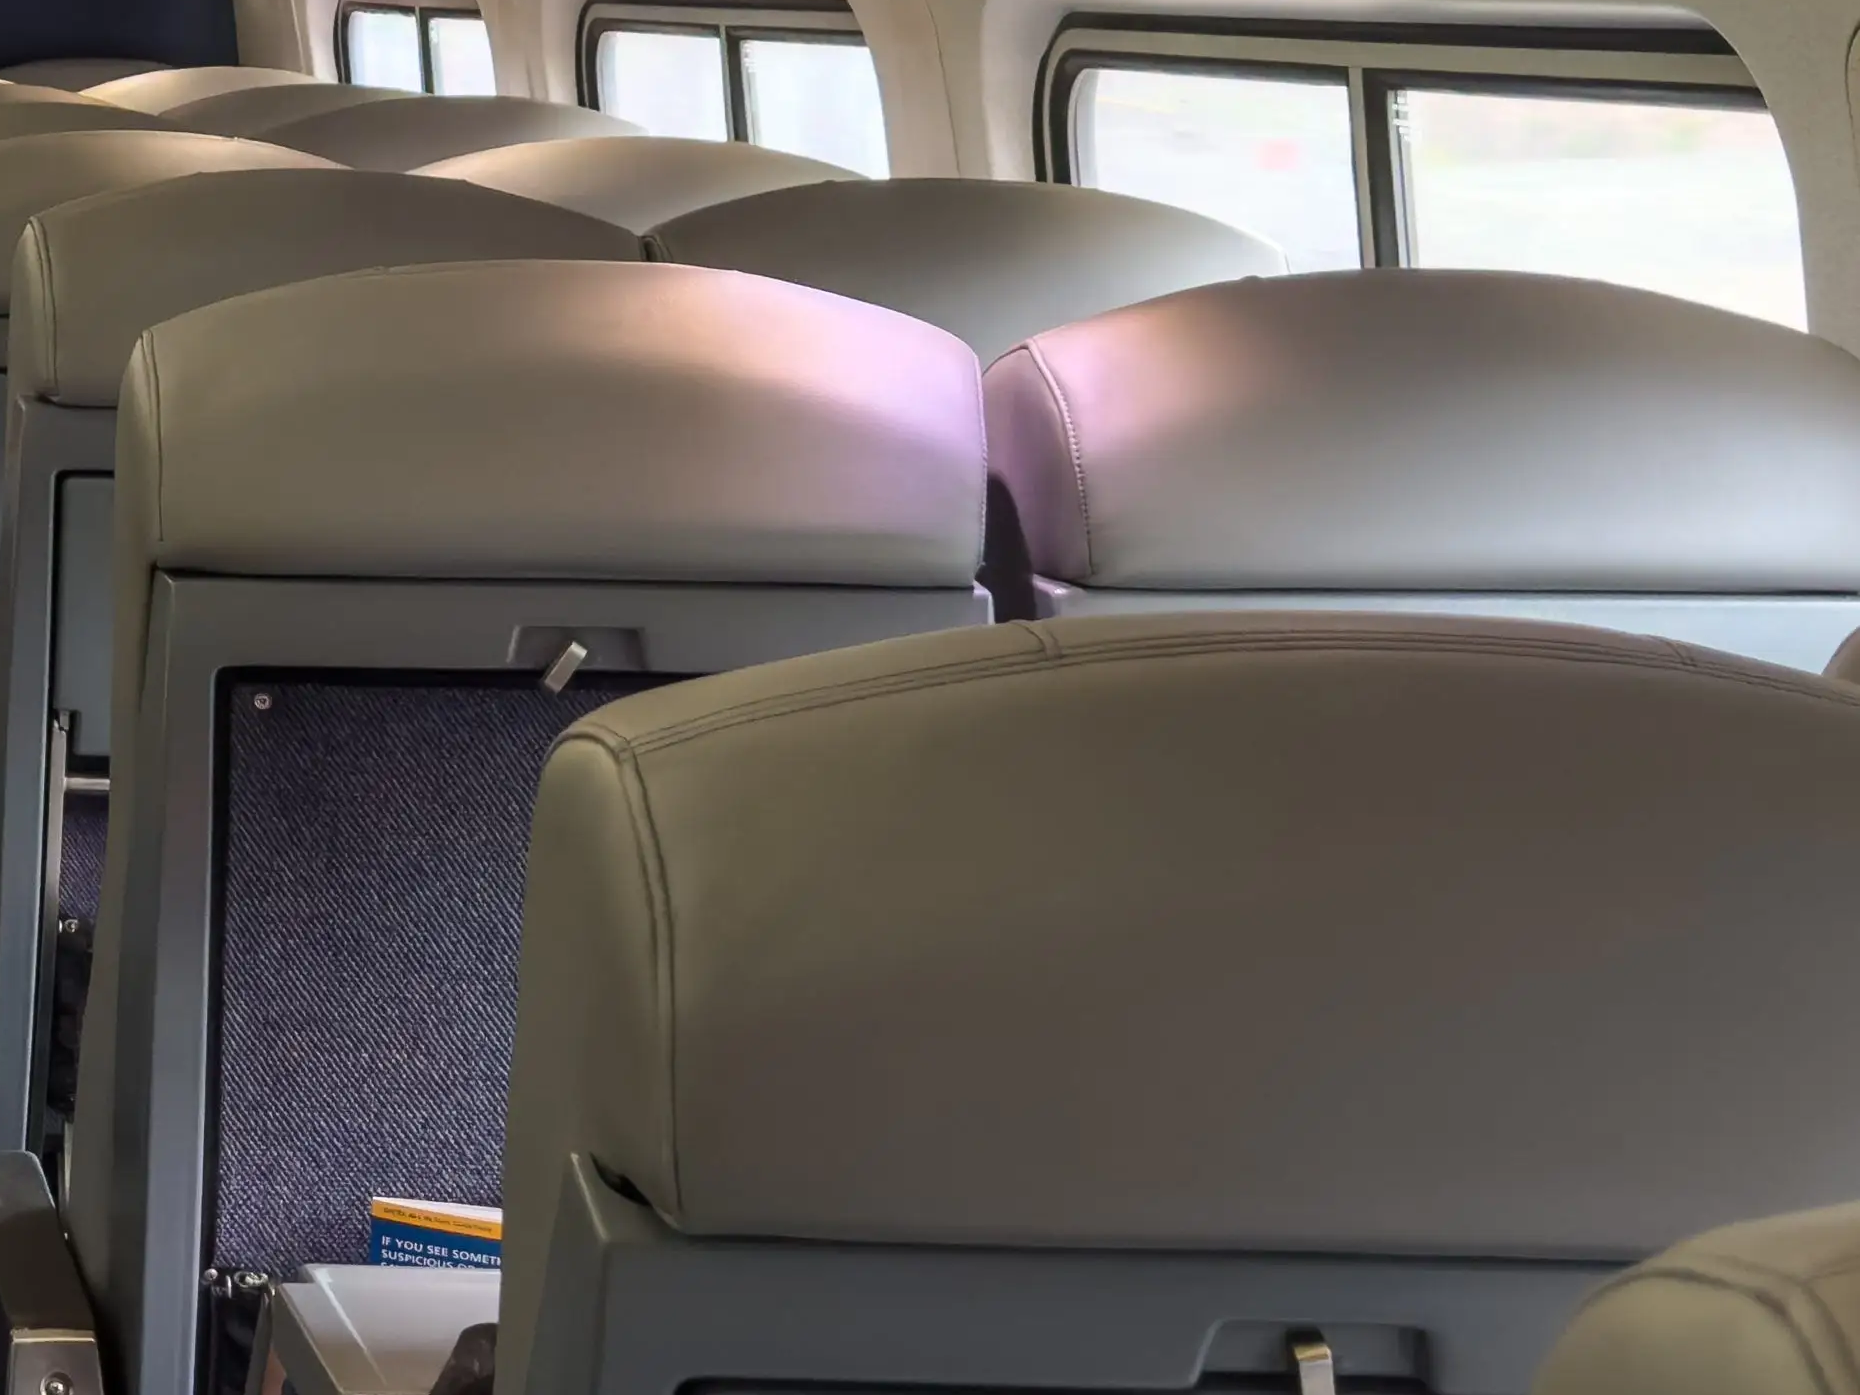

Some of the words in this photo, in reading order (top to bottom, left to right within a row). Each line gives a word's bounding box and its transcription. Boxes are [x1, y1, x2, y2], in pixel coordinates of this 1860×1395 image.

[381, 1235, 392, 1246] IF
[396, 1239, 423, 1252] YOU
[426, 1245, 448, 1258] SEE
